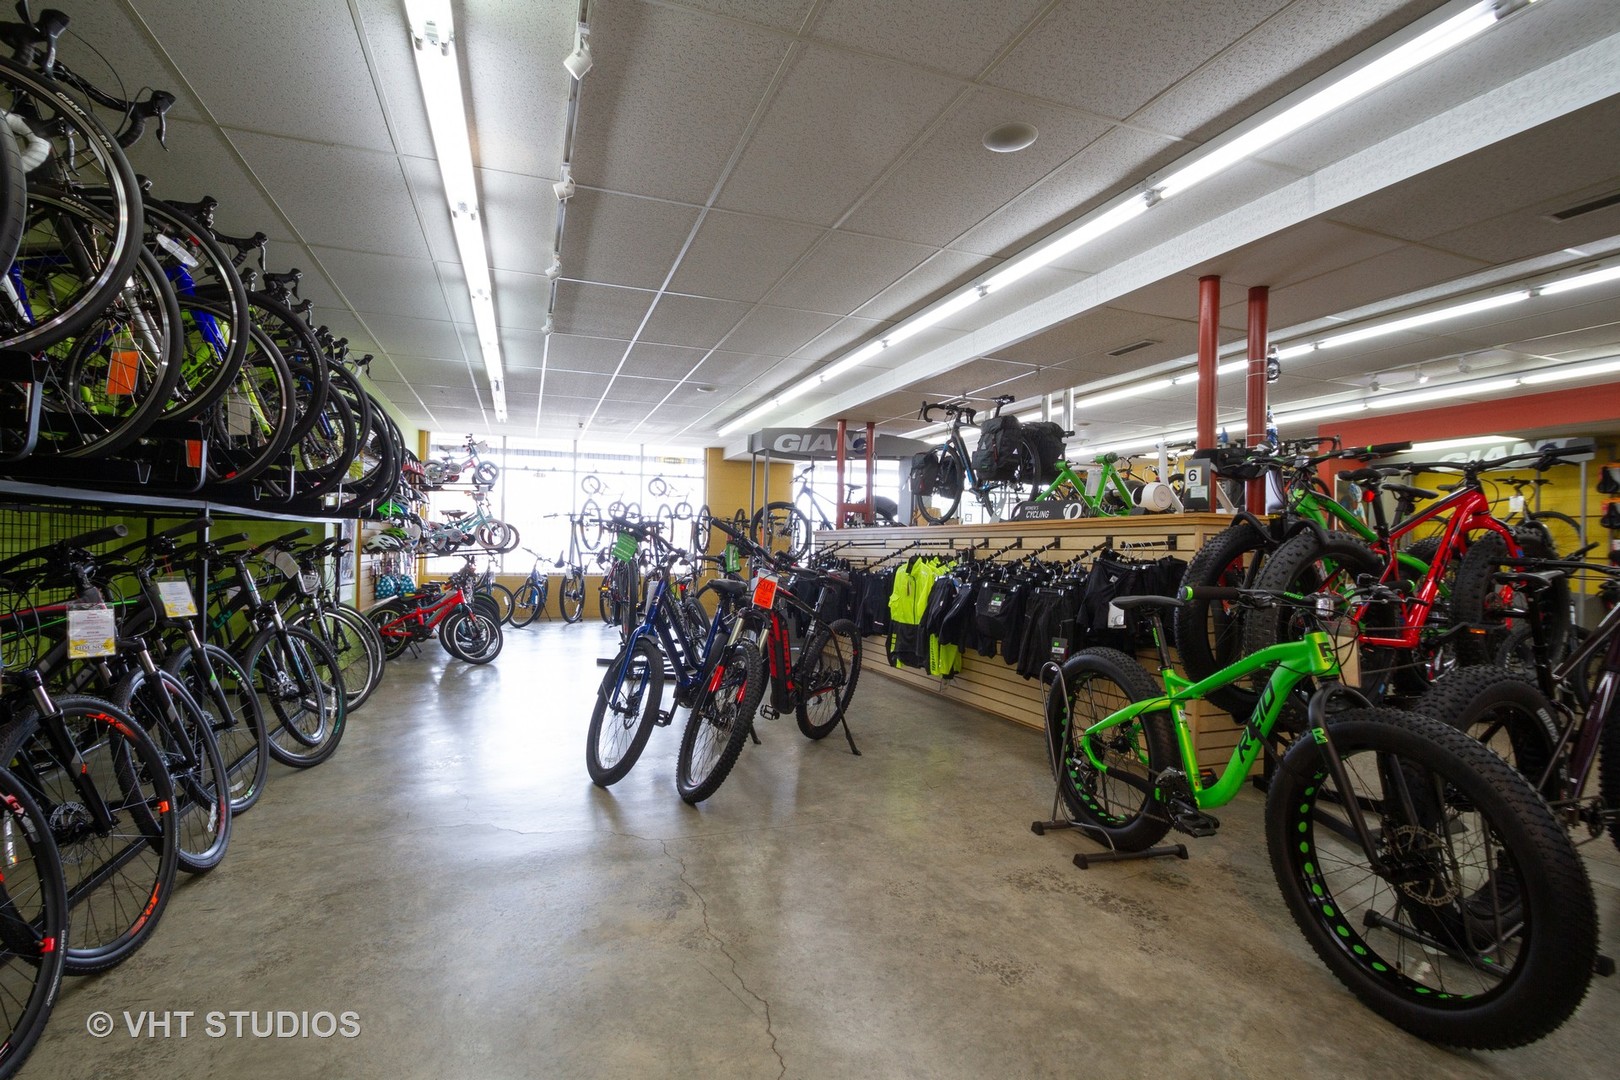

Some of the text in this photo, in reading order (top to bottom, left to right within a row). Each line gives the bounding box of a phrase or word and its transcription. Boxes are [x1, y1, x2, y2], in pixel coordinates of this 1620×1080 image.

[56, 92, 87, 116] GIANT
[61, 196, 91, 212] GIANT
[773, 433, 880, 452] GIAN
[1188, 469, 1197, 481] 6
[1025, 510, 1050, 519] CYCLING
